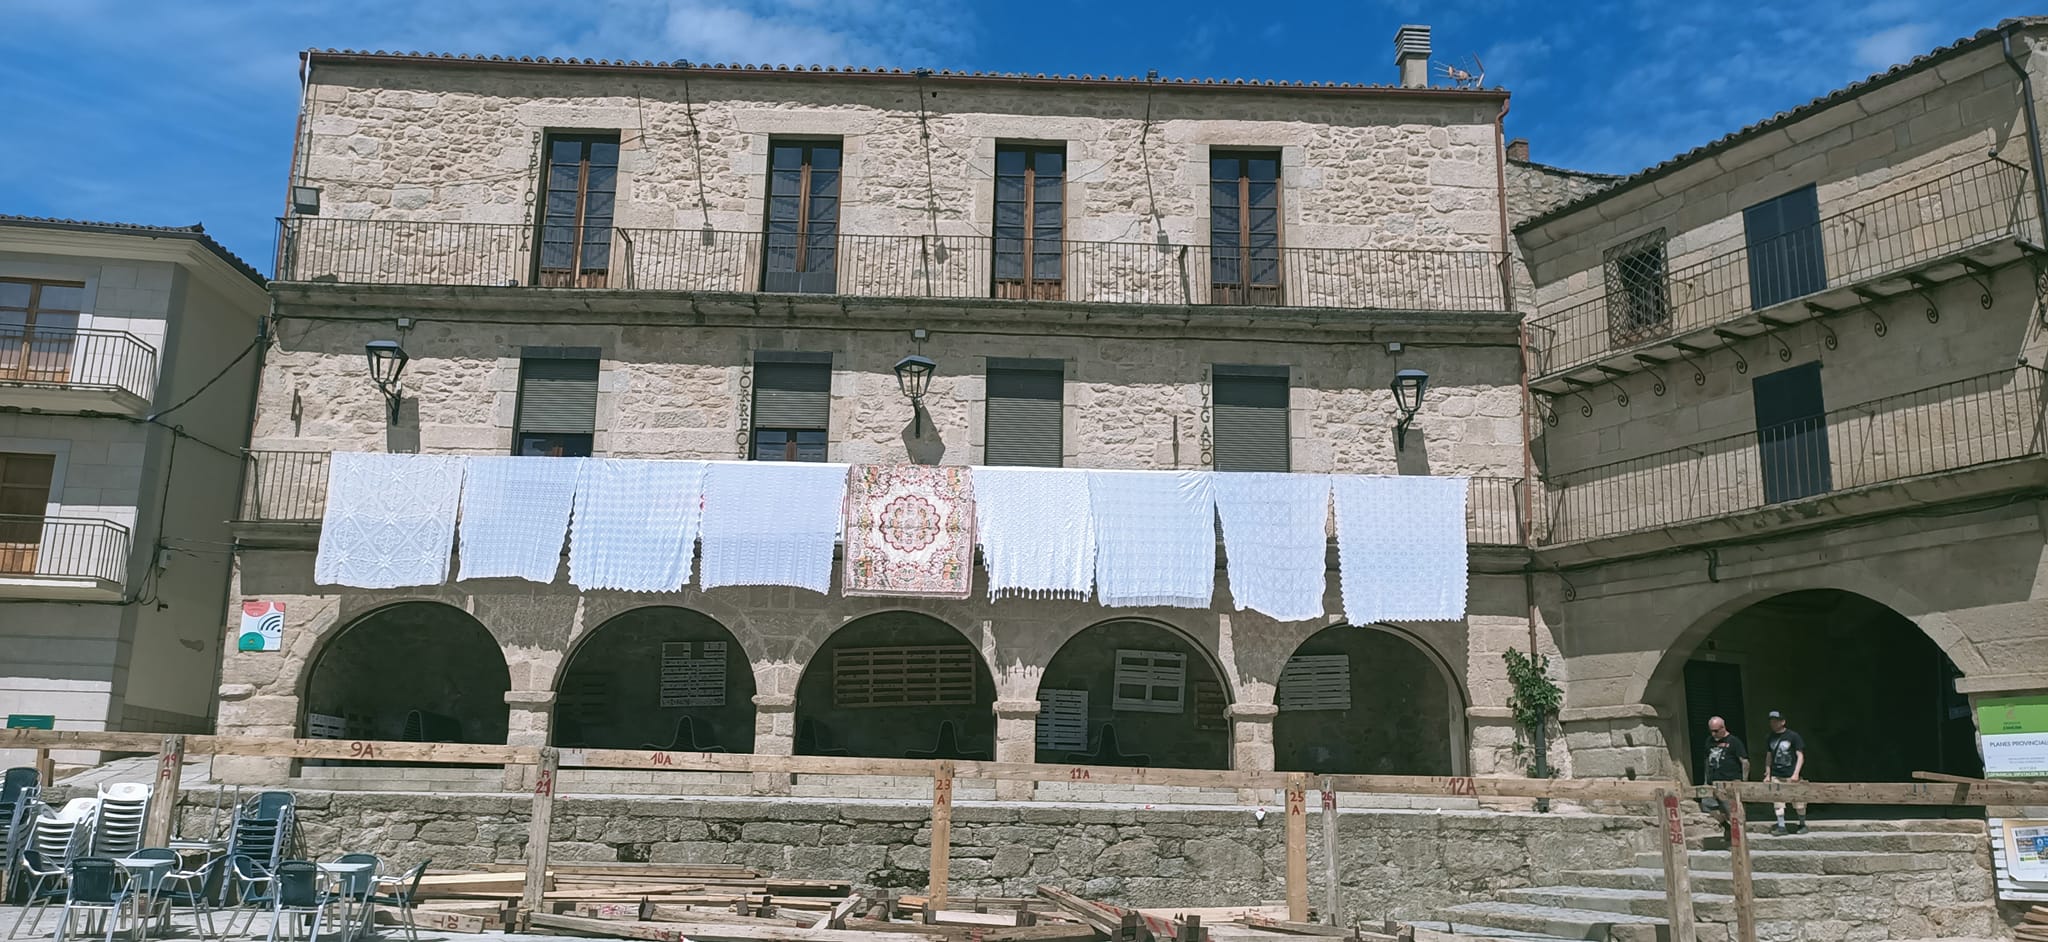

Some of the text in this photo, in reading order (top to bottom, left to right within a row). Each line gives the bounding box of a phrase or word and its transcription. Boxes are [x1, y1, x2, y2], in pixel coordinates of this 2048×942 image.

[518, 131, 541, 251] BIBLIOTECA
[736, 361, 752, 460] CORREOS
[1200, 368, 1213, 465] JUZGADO
[350, 741, 374, 759] 9A
[162, 753, 177, 767] 19
[650, 752, 673, 766] 10A
[1069, 767, 1090, 780] 11A
[936, 779, 950, 790] 23
[1449, 777, 1478, 796] 12A
[937, 794, 946, 805] A
[1290, 791, 1304, 802] 25
[1292, 804, 1301, 816] A
[447, 915, 459, 929] 20
